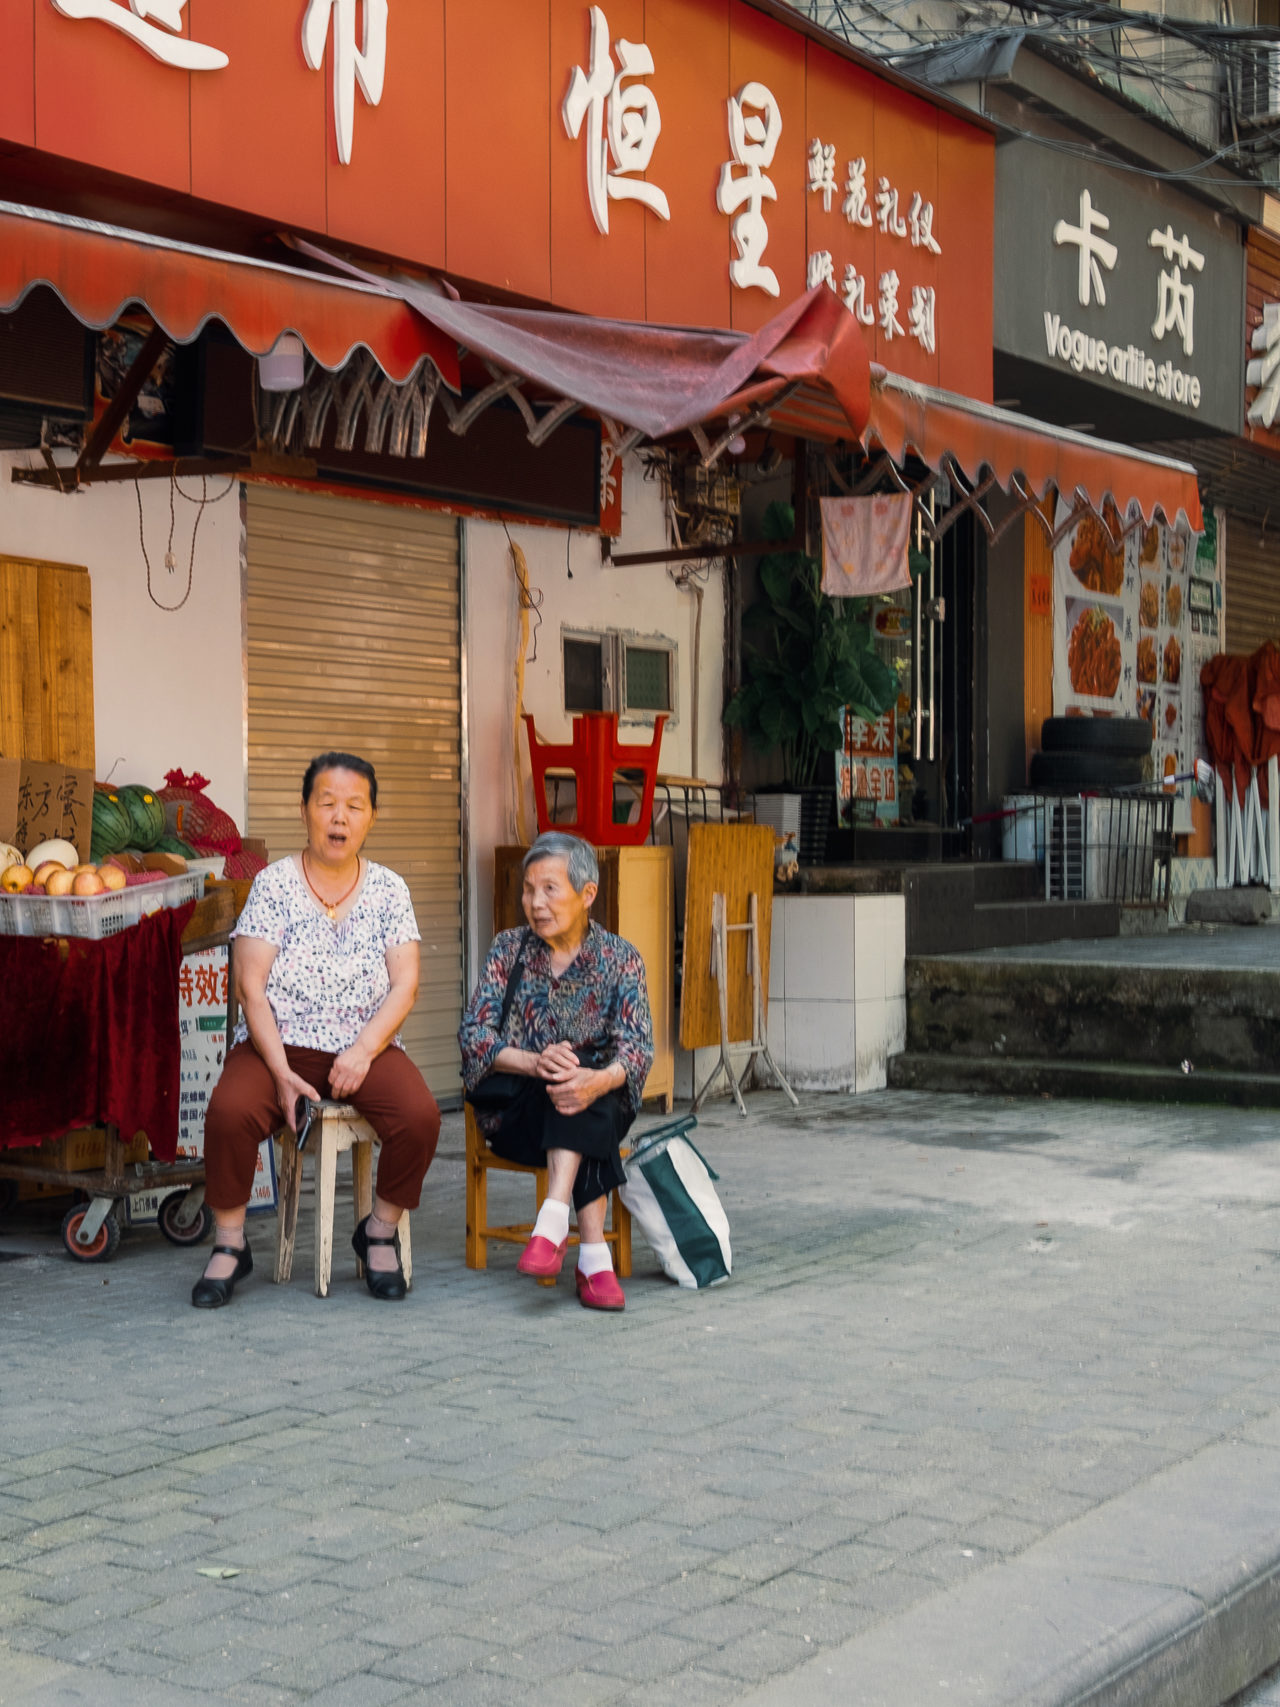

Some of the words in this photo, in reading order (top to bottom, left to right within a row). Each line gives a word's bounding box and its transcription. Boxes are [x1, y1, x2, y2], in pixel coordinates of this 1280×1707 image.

[807, 136, 942, 255] 鲜花礼仪
[1043, 311, 1108, 375] Vogue
[1156, 360, 1201, 409] store
